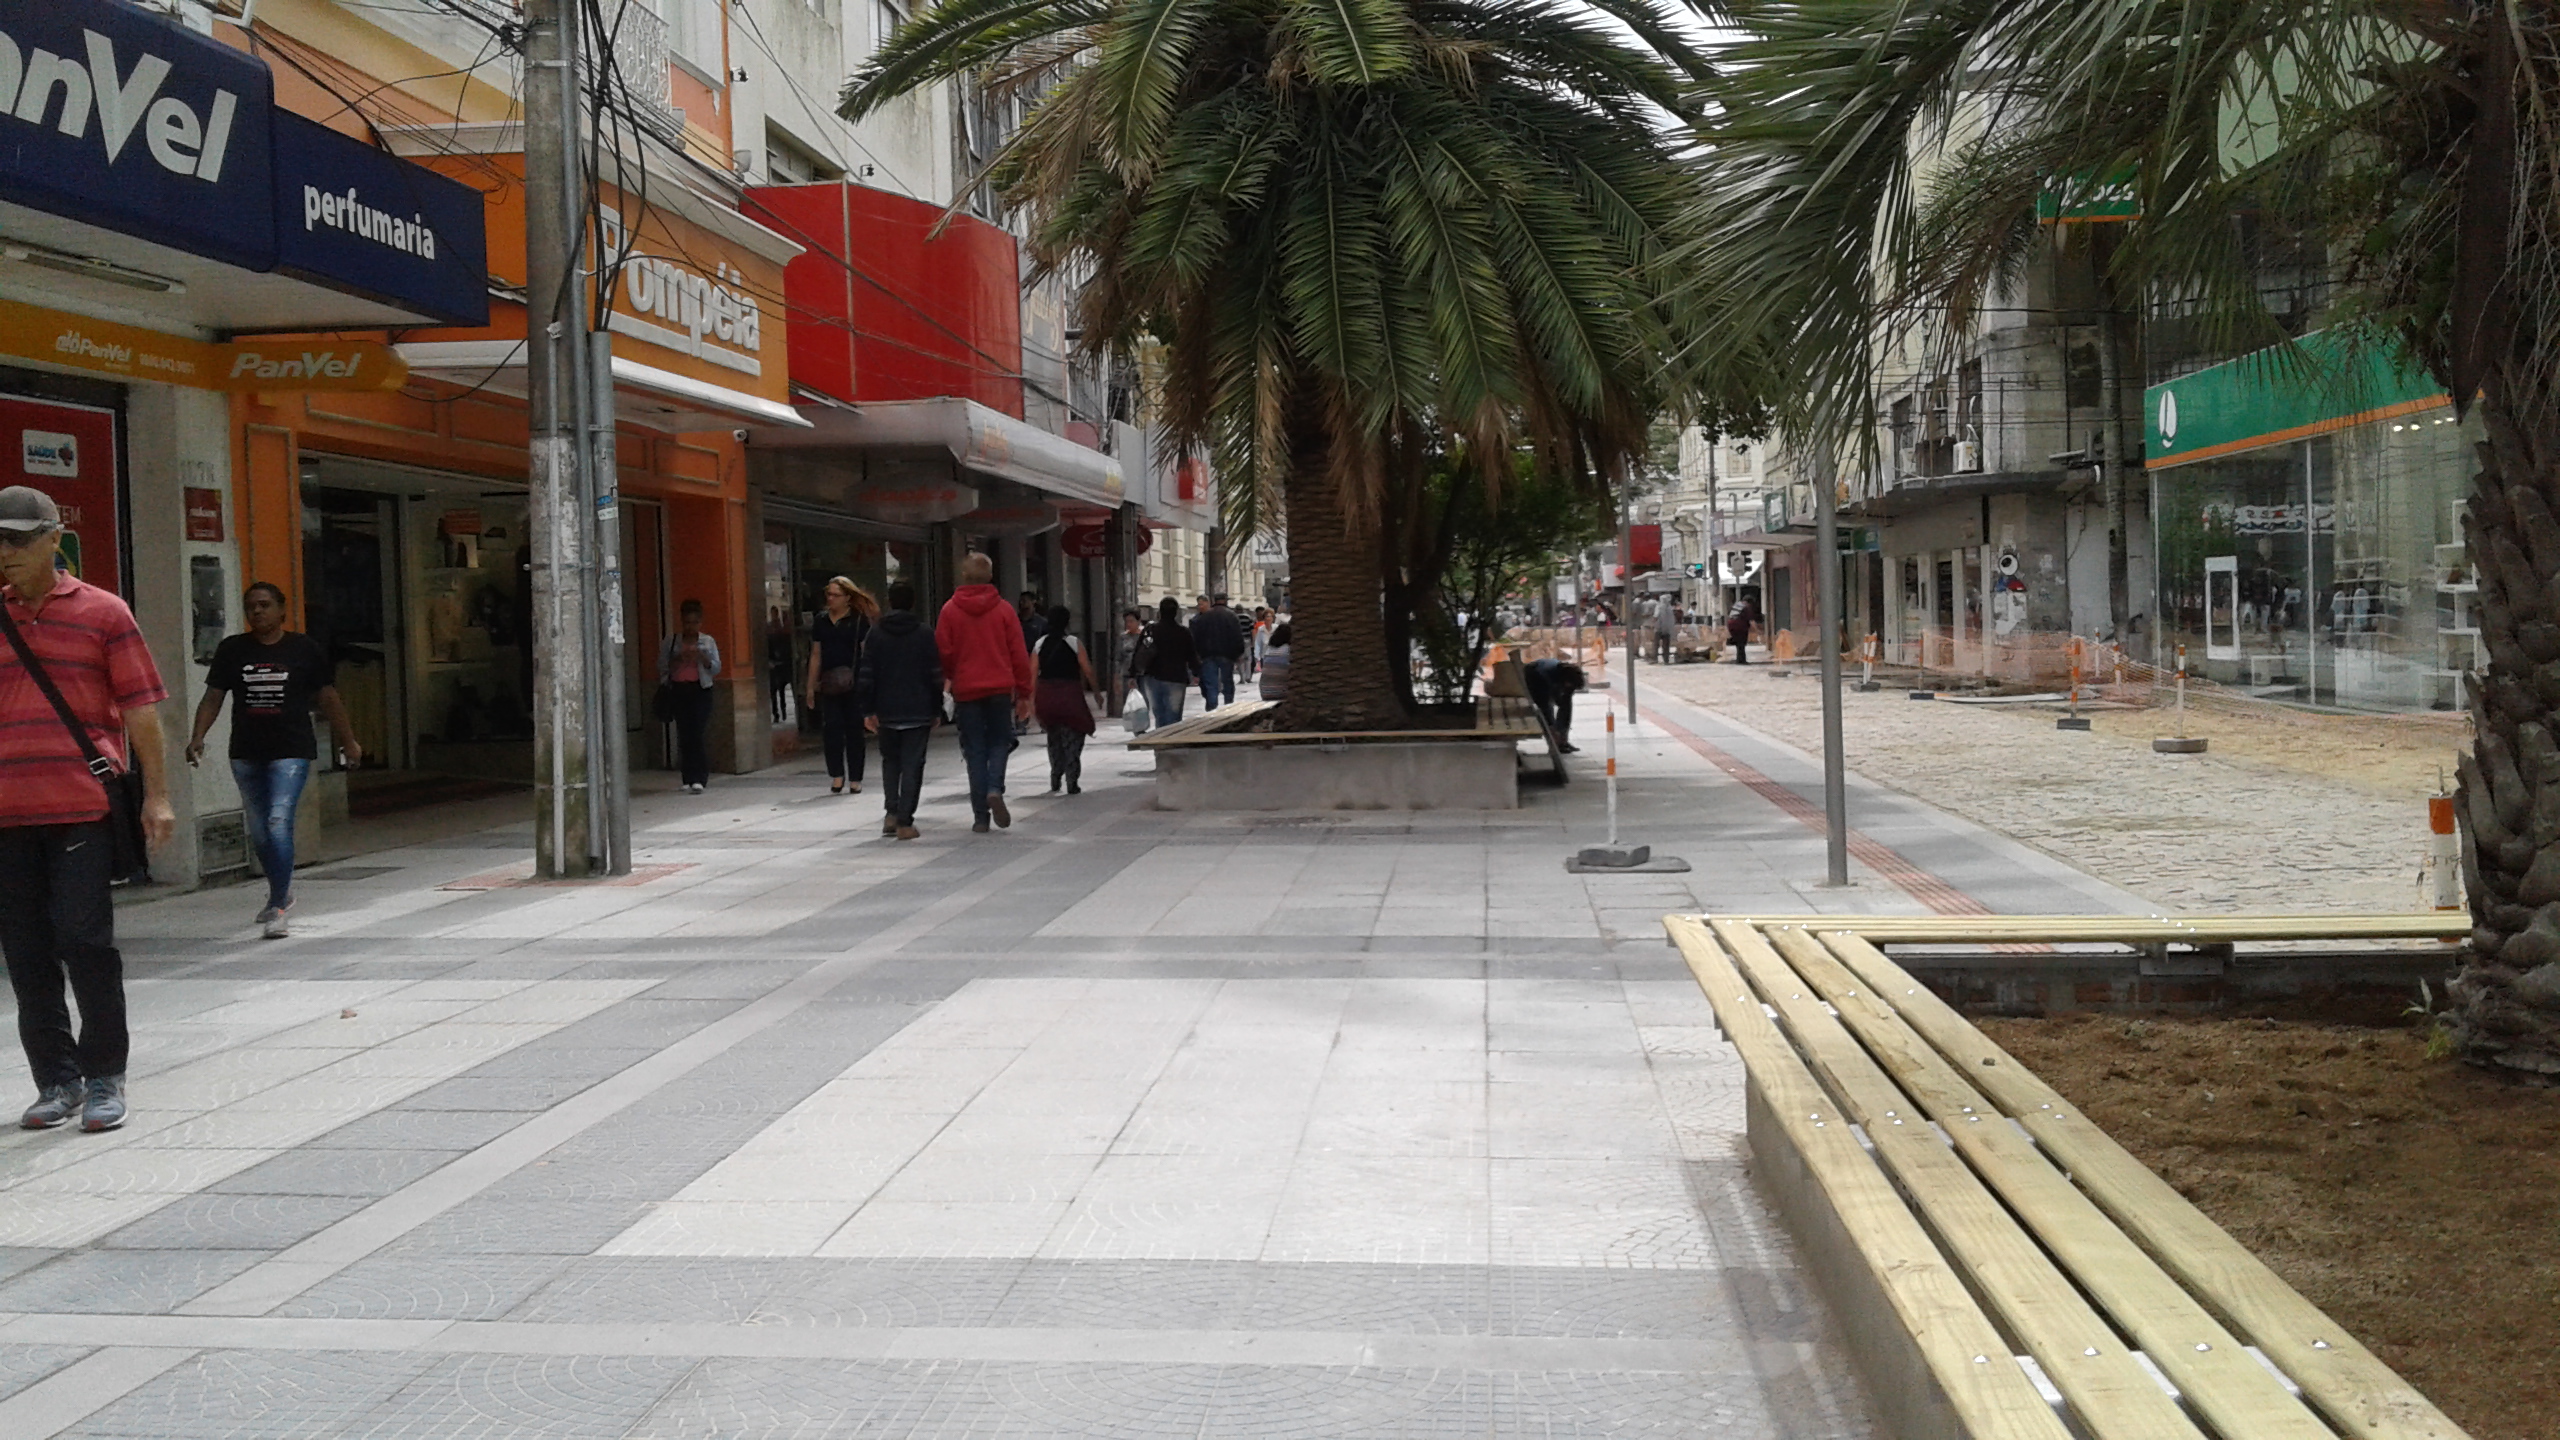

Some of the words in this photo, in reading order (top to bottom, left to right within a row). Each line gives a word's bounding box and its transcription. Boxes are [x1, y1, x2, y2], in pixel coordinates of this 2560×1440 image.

[304, 185, 435, 260] perfumaria
[594, 202, 760, 357] Pompéia
[229, 352, 362, 379] PanVel
